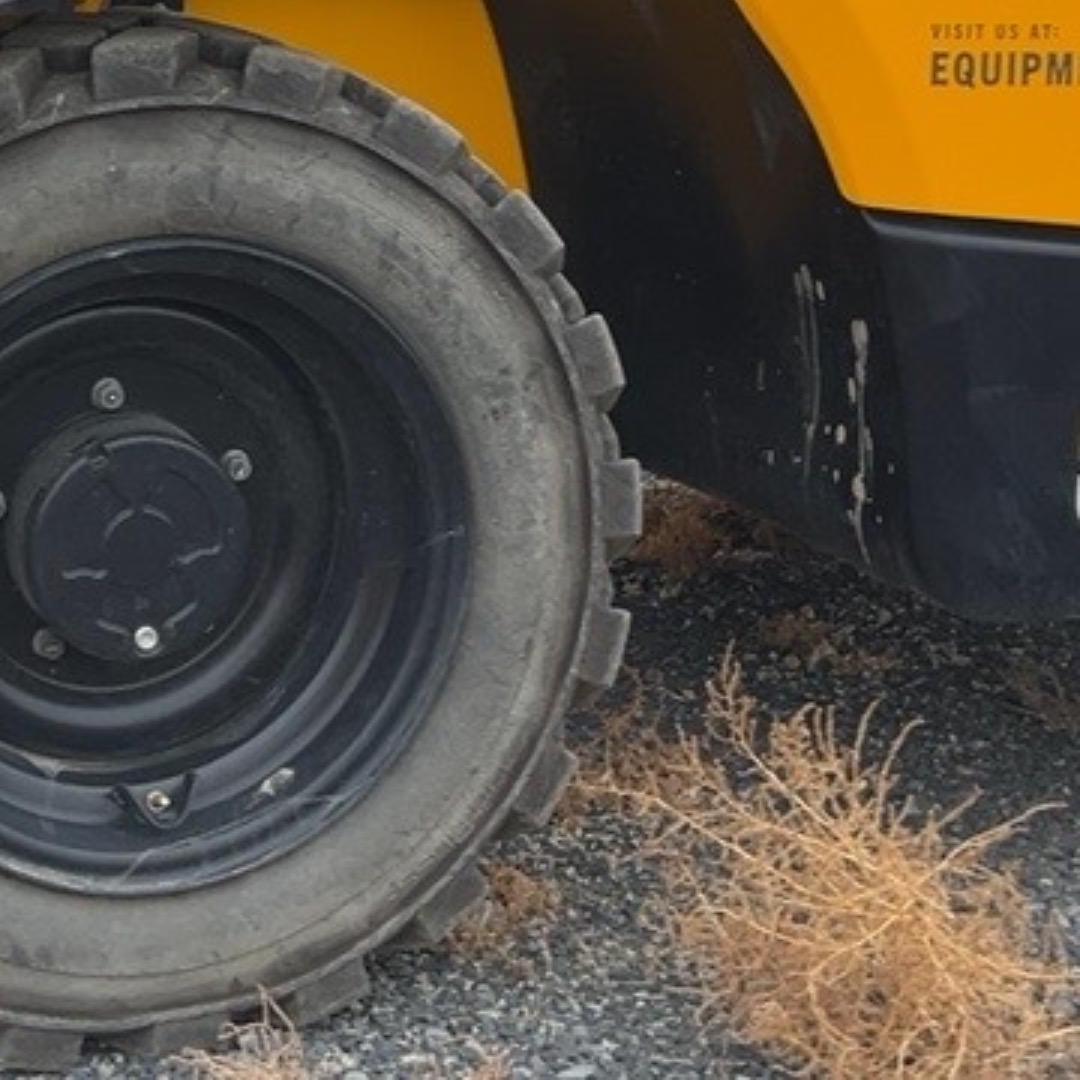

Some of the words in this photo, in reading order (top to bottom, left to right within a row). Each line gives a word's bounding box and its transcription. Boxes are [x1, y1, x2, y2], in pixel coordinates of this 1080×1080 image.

[929, 23, 985, 40] VISIT
[994, 23, 1019, 40] US
[930, 51, 1080, 89] EQUIPM
